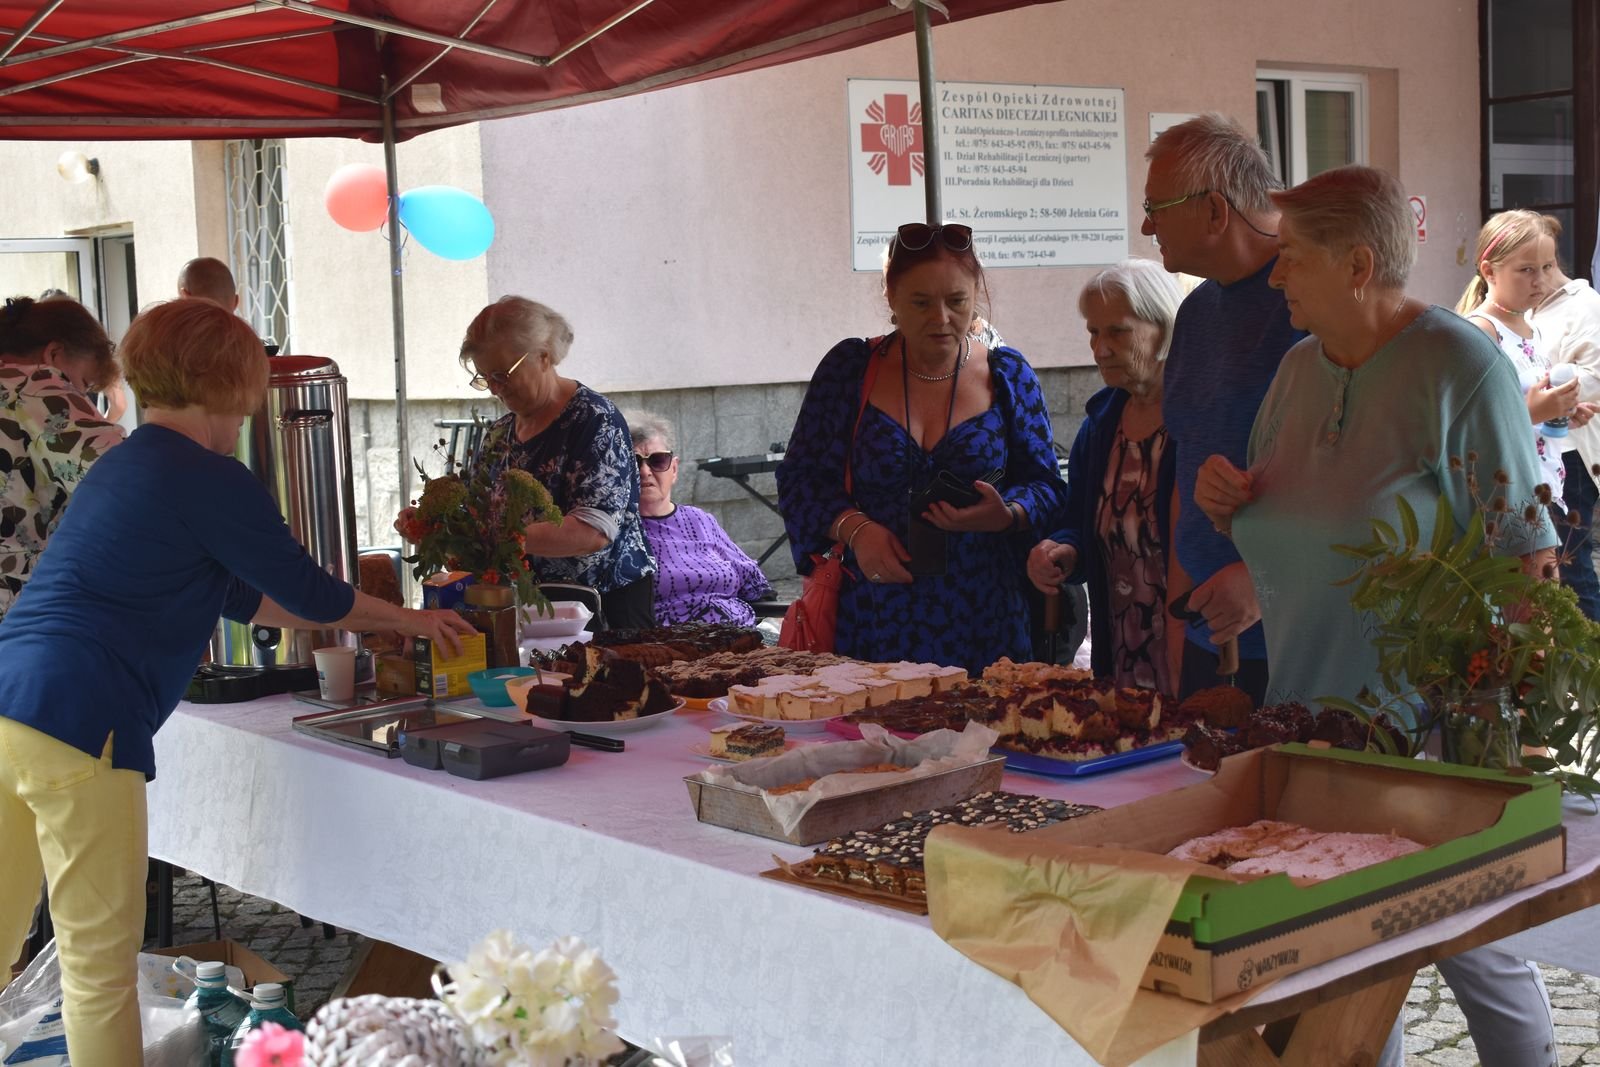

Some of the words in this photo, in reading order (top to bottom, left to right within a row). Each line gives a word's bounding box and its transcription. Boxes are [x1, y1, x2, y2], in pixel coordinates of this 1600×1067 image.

[992, 91, 1038, 106] Opieki
[1042, 94, 1117, 110] Zdrowotnej
[942, 106, 994, 120] CARITAS
[996, 107, 1048, 121] DIECEZJI
[1051, 110, 1117, 123] LEGNICKIEJ
[880, 123, 914, 158] CARITAS
[992, 139, 1026, 149] 643-45-92
[977, 152, 1024, 163] Rehabilitacji
[1025, 153, 1061, 164] Leczniczej
[1063, 154, 1090, 165] (parter)
[992, 177, 1038, 188] Rehabilitacji
[1040, 178, 1051, 187] dla
[1052, 178, 1074, 187] Dzieci
[960, 208, 971, 218] St.
[974, 206, 1028, 219] Żeromskiego
[1040, 207, 1067, 218] 58-500
[1069, 207, 1096, 218] Jelenia
[1098, 207, 1119, 218] Góra
